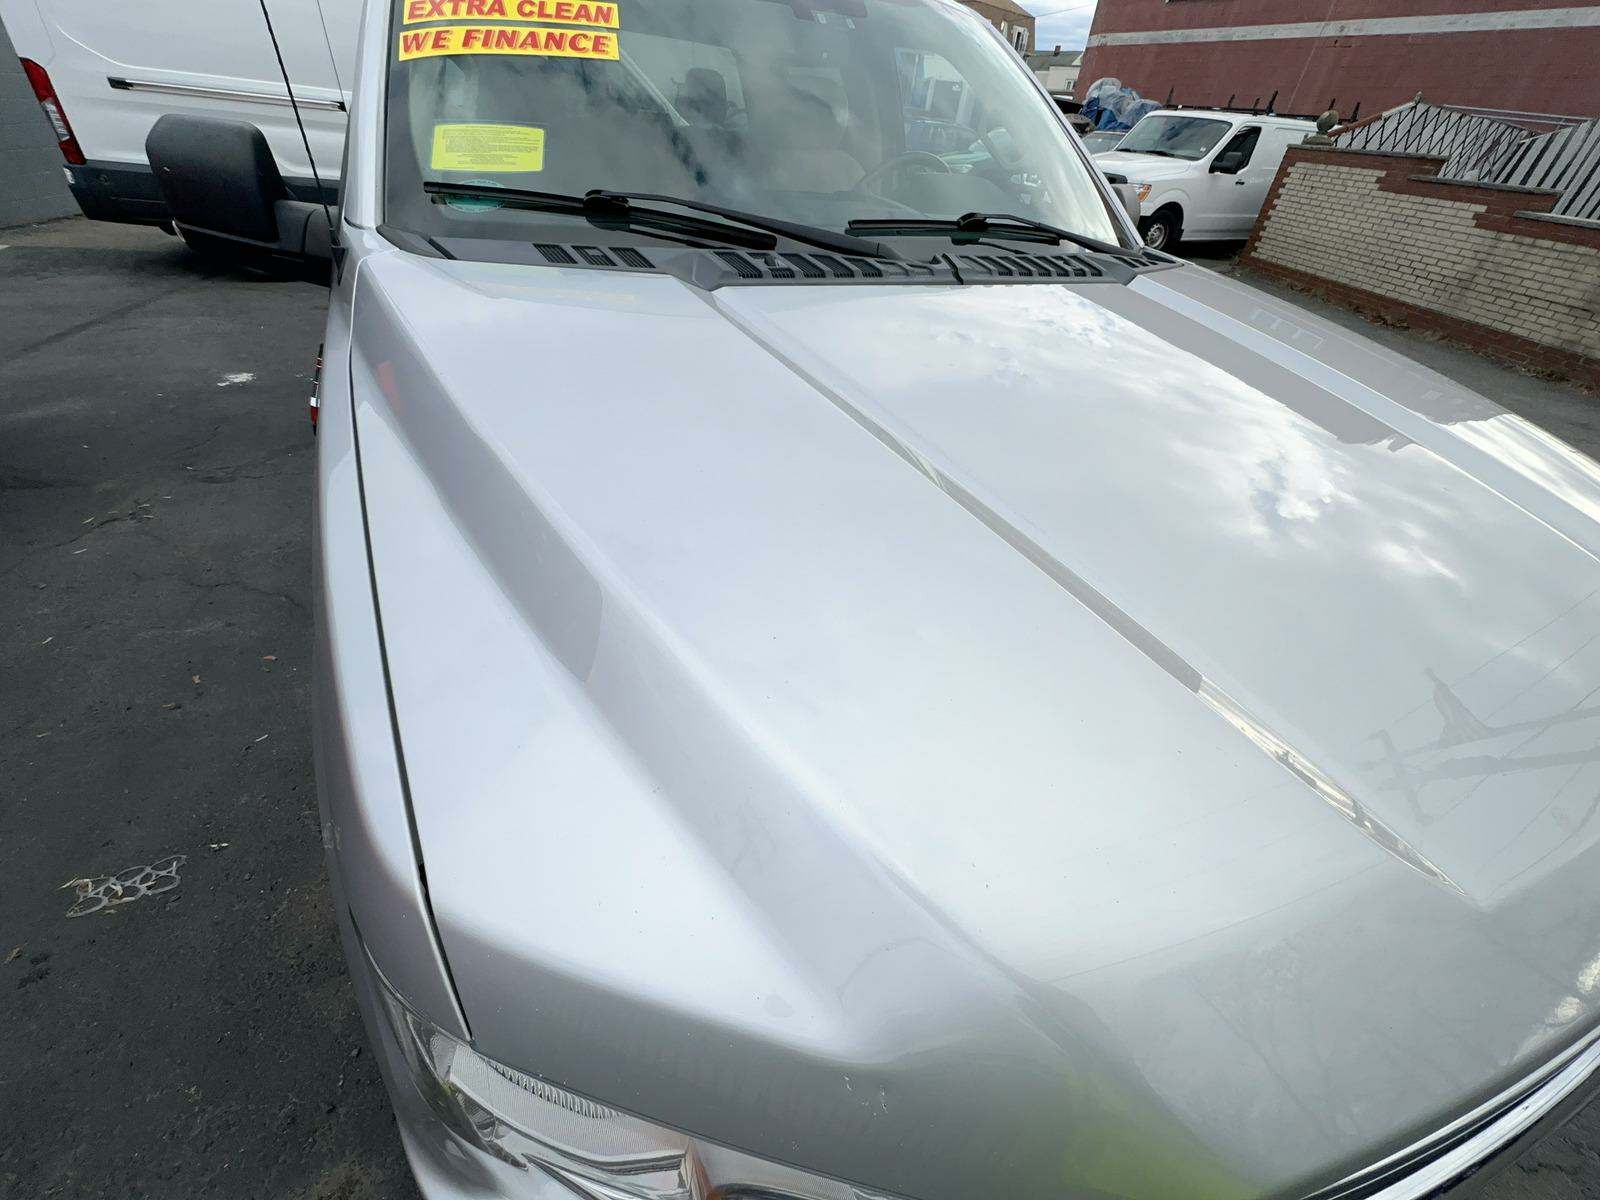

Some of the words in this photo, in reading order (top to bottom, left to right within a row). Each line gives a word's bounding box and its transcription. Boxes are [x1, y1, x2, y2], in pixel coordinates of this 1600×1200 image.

[407, 0, 505, 20] EXTRA
[516, 1, 613, 24] CLEAN
[402, 29, 451, 53] WE
[462, 28, 612, 54] FINANCE
